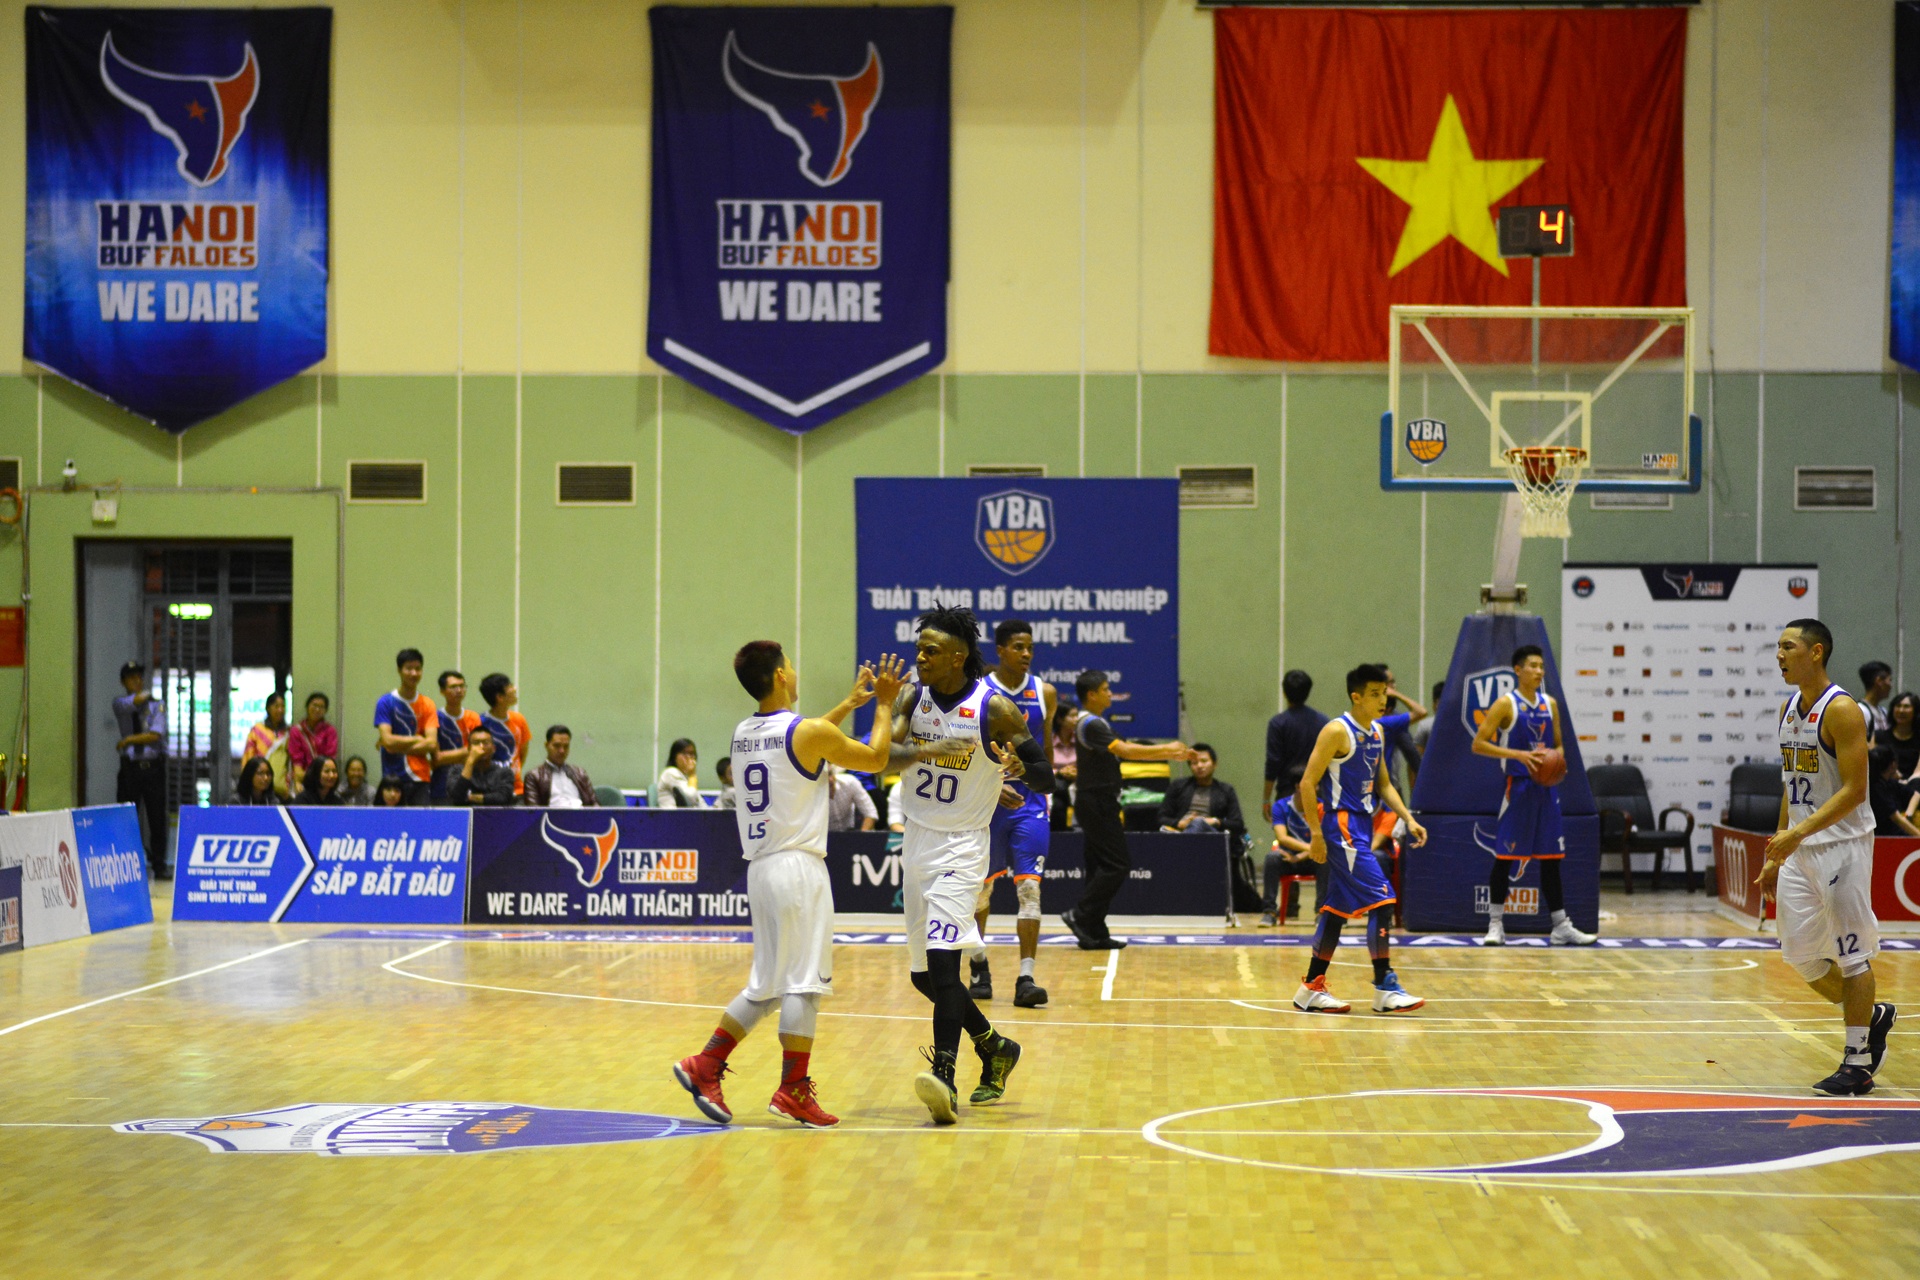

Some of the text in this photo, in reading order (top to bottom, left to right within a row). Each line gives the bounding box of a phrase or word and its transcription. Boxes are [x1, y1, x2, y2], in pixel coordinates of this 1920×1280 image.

[99, 204, 256, 243] HANOI
[721, 204, 878, 243] HANOI
[1540, 209, 1564, 245] 4
[100, 245, 256, 267] BUFFALOES
[722, 245, 878, 267] BUFFALOES
[98, 281, 260, 323] WE DARE
[718, 280, 883, 323] WE DARE
[1409, 420, 1443, 441] VBA
[984, 495, 1046, 530] VBA
[763, 736, 785, 750] MINH
[744, 762, 770, 813] 9
[915, 768, 959, 804] 20
[1789, 777, 1814, 805] 12
[748, 821, 767, 840] LS
[203, 840, 271, 863] VUG
[317, 833, 366, 861] MÙA
[372, 831, 415, 862] GIẢI
[85, 843, 142, 893] vinaphone
[620, 851, 697, 870] HANOI
[1034, 855, 1046, 874] 3
[310, 863, 456, 897] SẮP BẮT ĐẦU
[620, 871, 697, 882] BUFFALOES
[1067, 867, 1082, 879] và
[487, 892, 515, 916] WE
[519, 893, 569, 916] DARE
[586, 889, 627, 917] DÁM
[631, 889, 693, 917] THÁCH
[1476, 887, 1538, 904] HNOI
[1476, 904, 1538, 914] BUALOES
[927, 919, 959, 943] 20
[1836, 933, 1860, 957] 12
